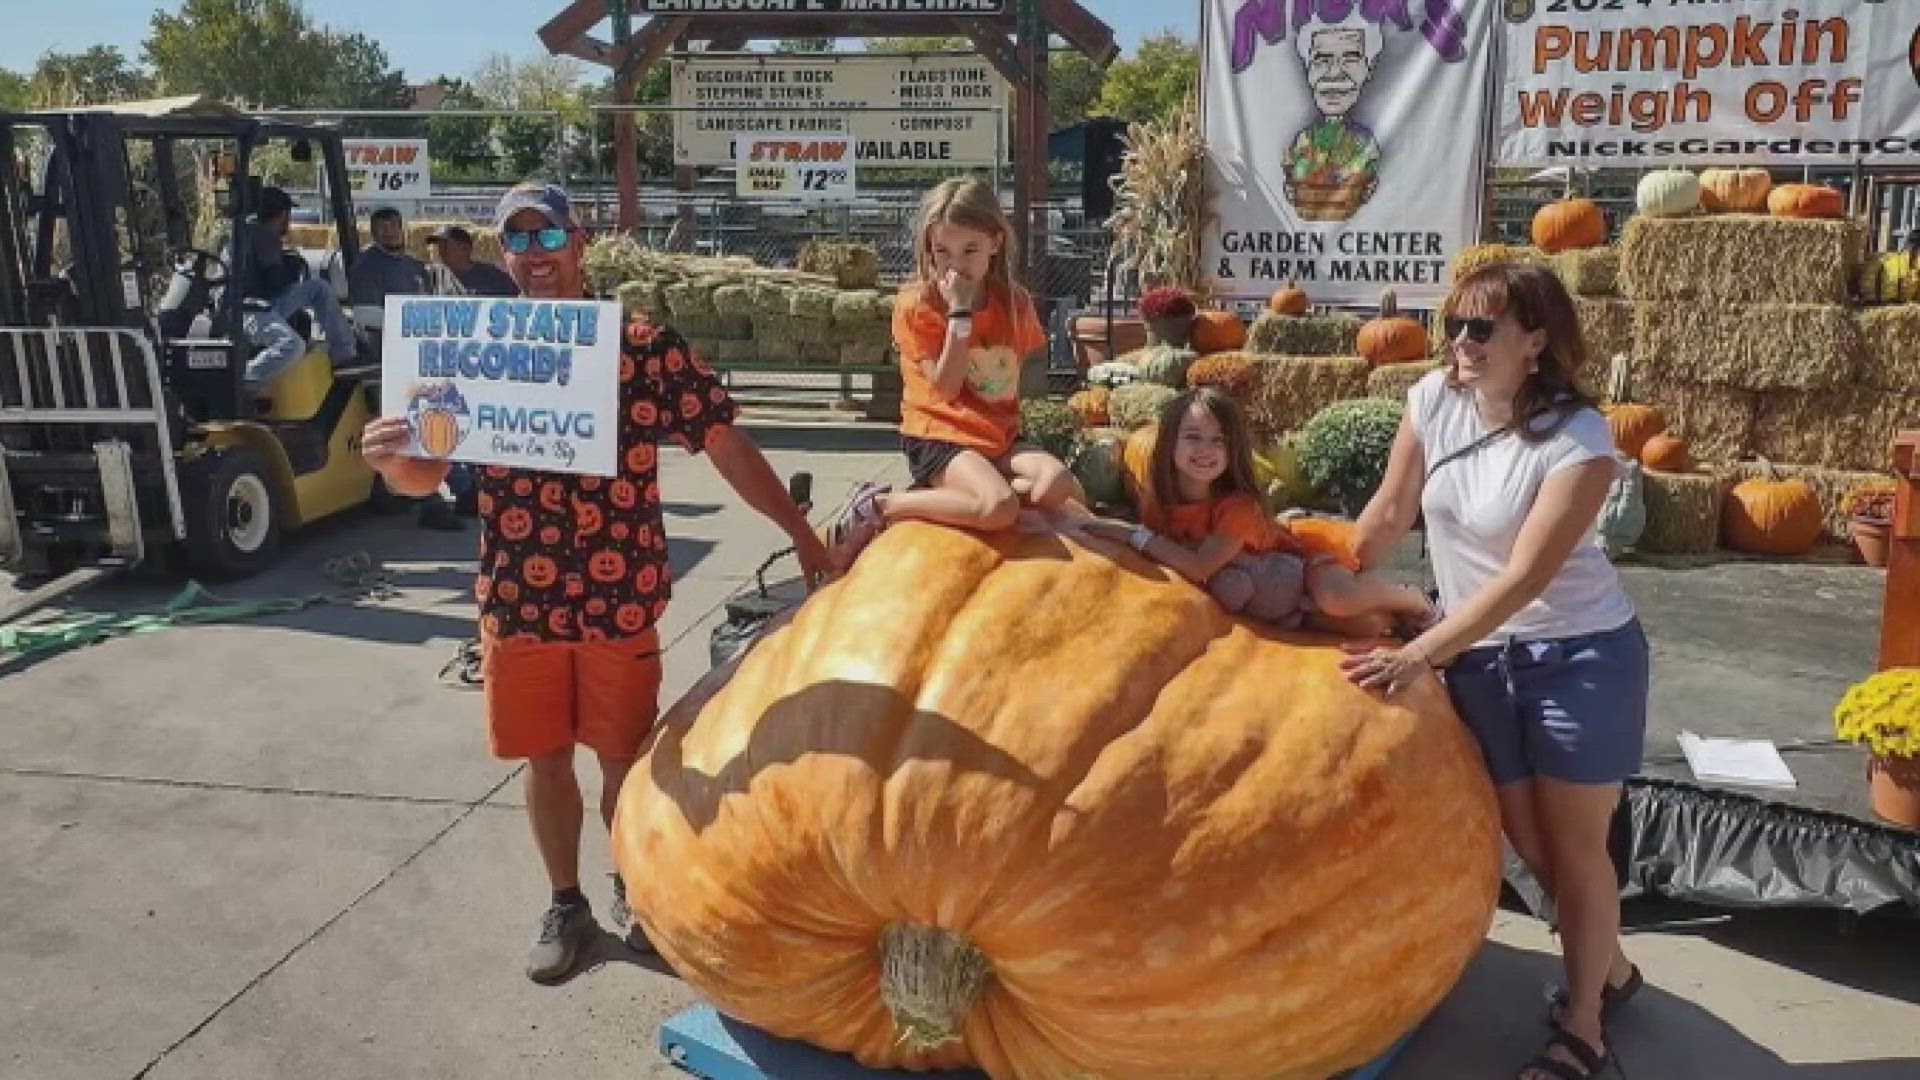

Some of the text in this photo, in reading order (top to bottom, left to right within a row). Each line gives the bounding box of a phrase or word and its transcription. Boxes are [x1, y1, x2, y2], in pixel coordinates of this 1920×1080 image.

[1532, 11, 1850, 79] Pumpkin
[793, 70, 833, 83] ROCK
[900, 68, 988, 82] FLAGSTONE
[900, 84, 992, 98] MOSS ROCK
[1744, 79, 1863, 123] Off
[696, 118, 842, 131] LANDSCAPE FABRIC
[900, 116, 973, 131] COMPOST
[749, 141, 848, 162] STRAW
[1222, 231, 1443, 256] GARDEN CENTER
[1217, 258, 1446, 284] & FARM MARKET
[402, 300, 598, 347] NEW STATE
[418, 340, 573, 386] RECORD!
